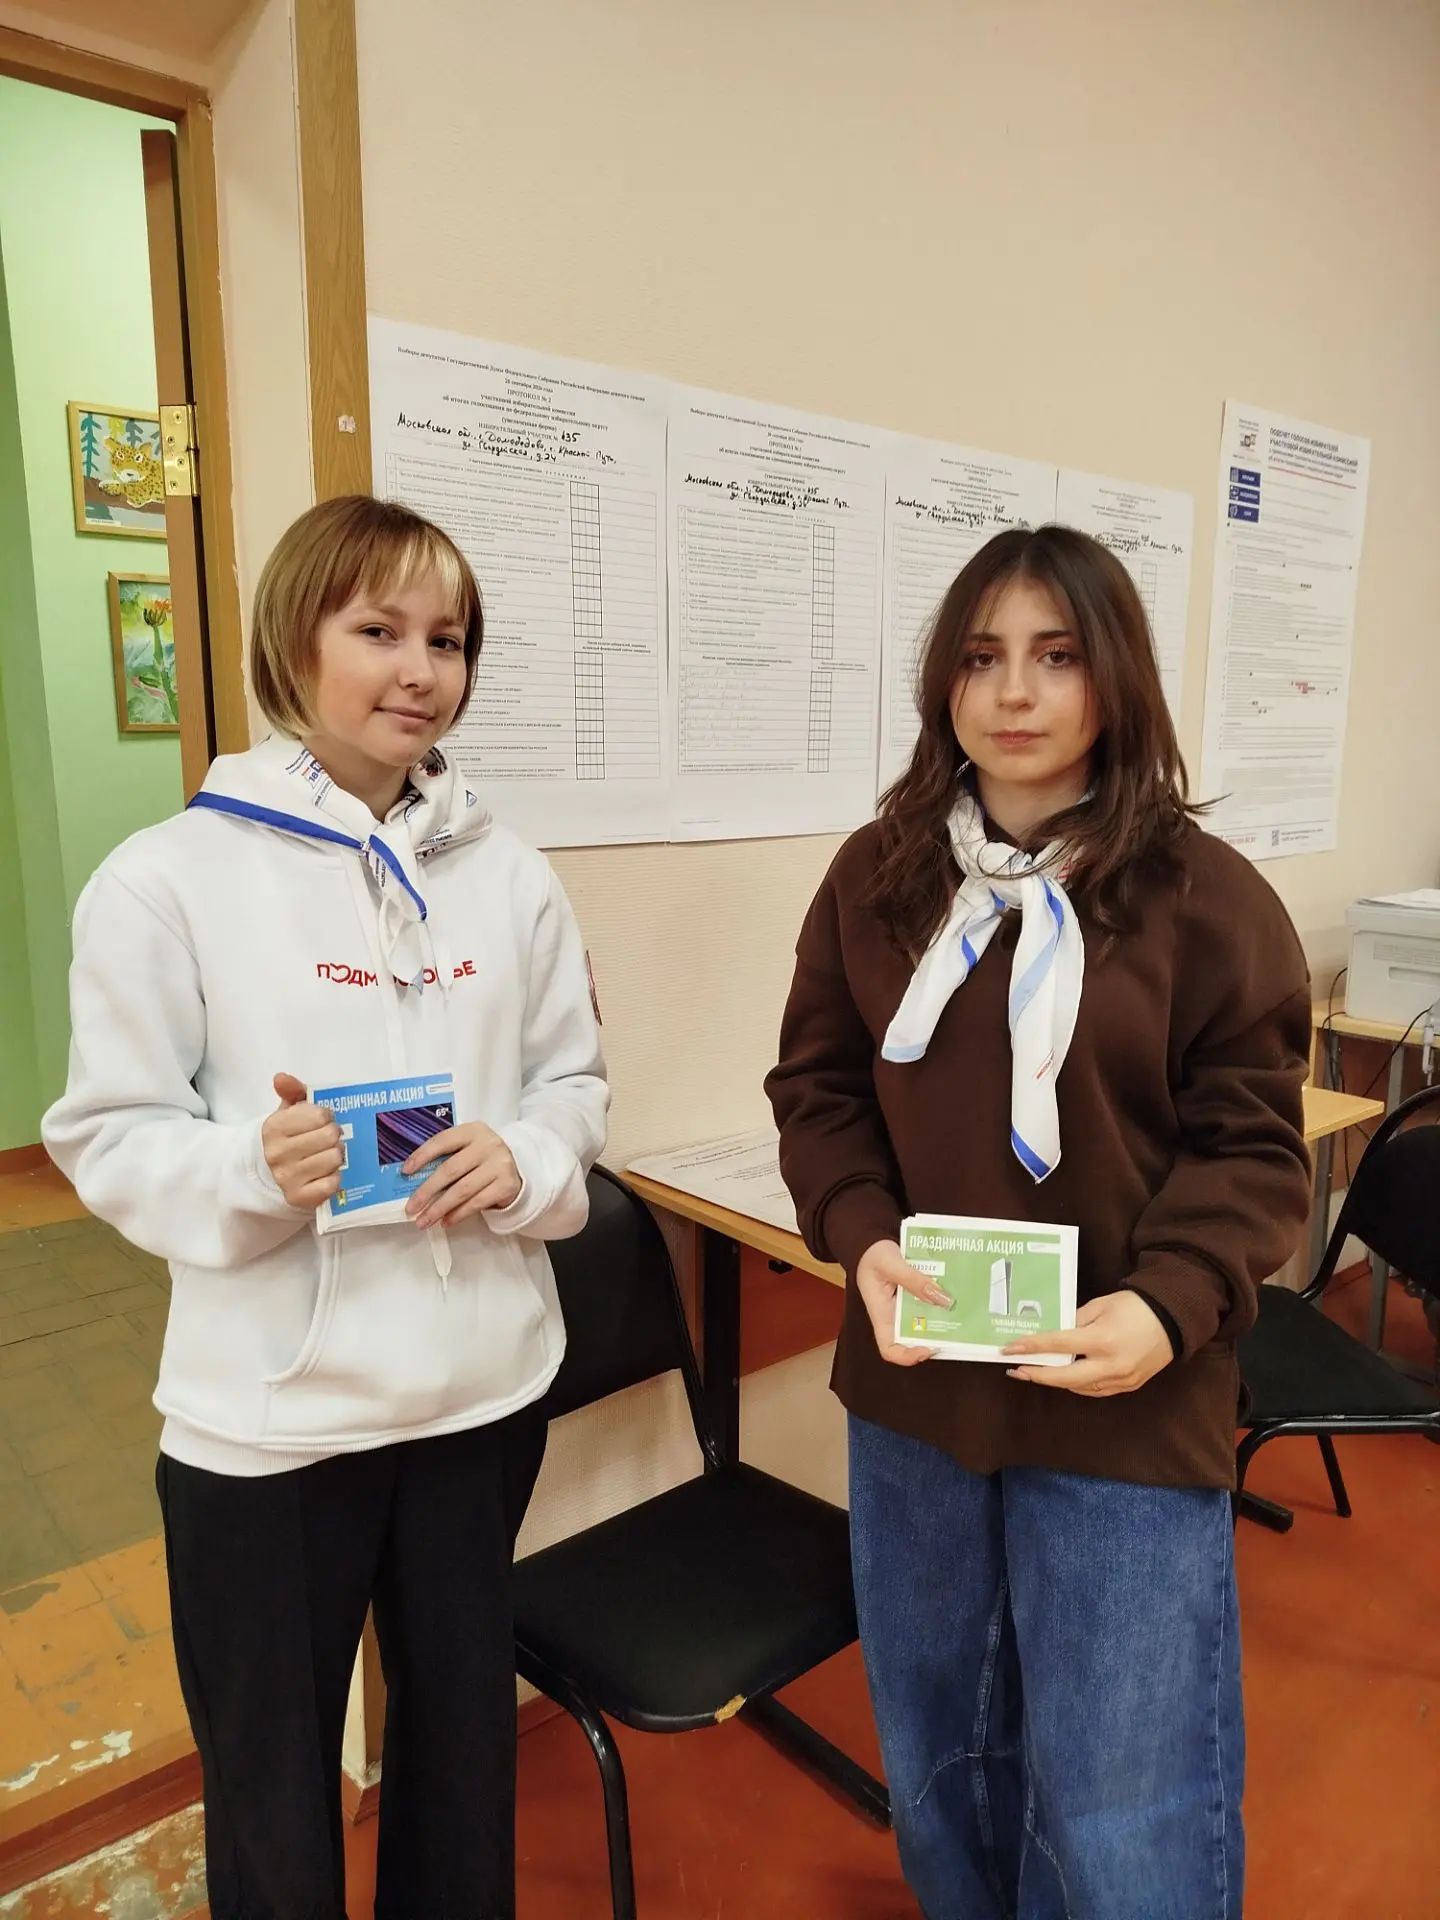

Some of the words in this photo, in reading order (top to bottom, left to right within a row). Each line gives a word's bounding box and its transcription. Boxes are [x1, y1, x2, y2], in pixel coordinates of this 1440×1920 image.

[397, 411, 452, 435] Московская
[389, 1086, 425, 1105] АКЦИЯ
[909, 1234, 984, 1252] ПРАЗДНИЧНАЯ
[985, 1239, 1025, 1256] АКЦИЯ
